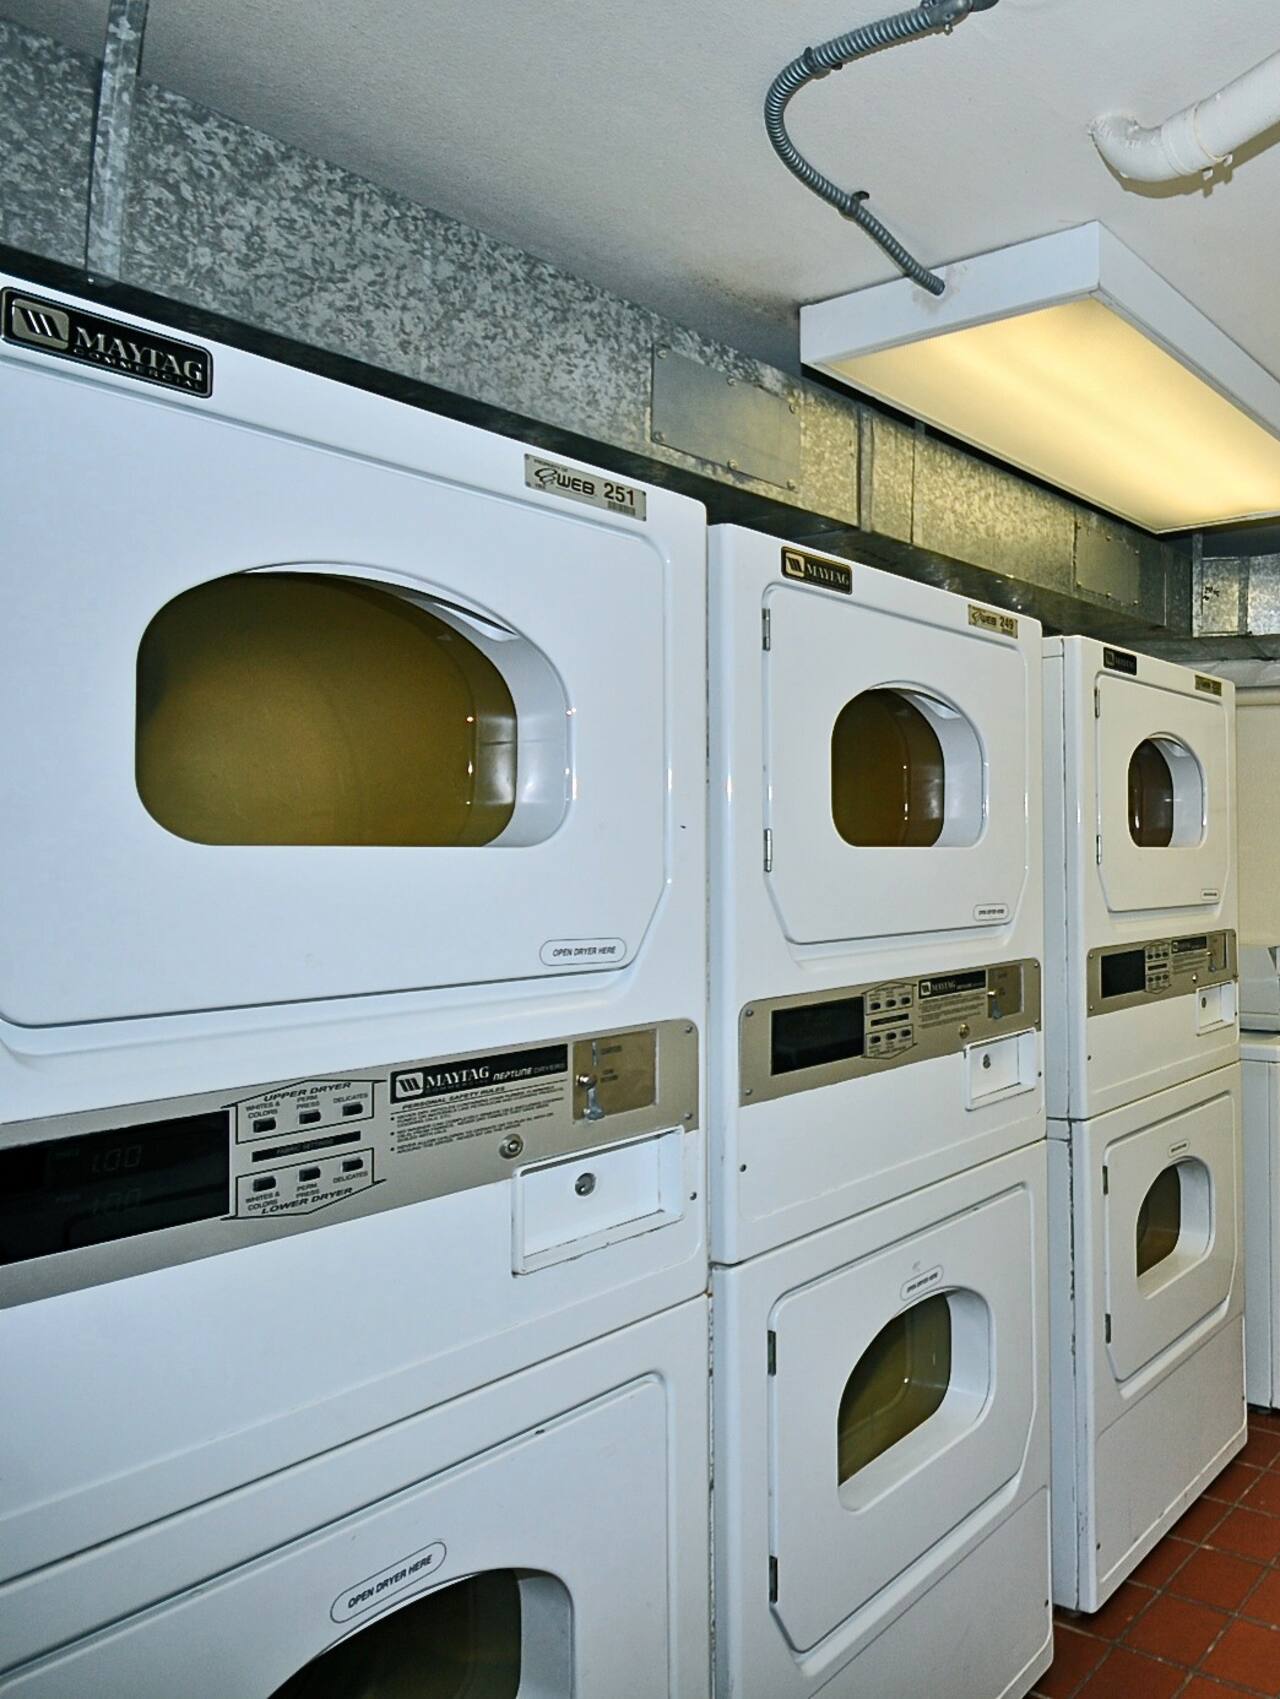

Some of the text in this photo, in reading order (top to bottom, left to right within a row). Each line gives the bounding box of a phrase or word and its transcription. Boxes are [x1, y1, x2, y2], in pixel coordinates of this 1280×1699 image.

[75, 326, 203, 382] MAYTAG
[556, 473, 635, 506] WEB 251
[806, 562, 849, 585] MAYTAG
[552, 945, 617, 957] OPEN DRYER HERE
[425, 1065, 490, 1089] MAYTAG
[492, 1066, 533, 1081] NEPTUNE
[263, 1081, 352, 1102] UPPER DRYER
[333, 1092, 369, 1104] DELICATES
[245, 1102, 273, 1112] WHITES
[247, 1108, 279, 1119] COLORS
[333, 1171, 369, 1184] DELICATES
[262, 1187, 353, 1215] LOWER DRYER
[348, 1553, 433, 1609] OPEN DRYER HERE
